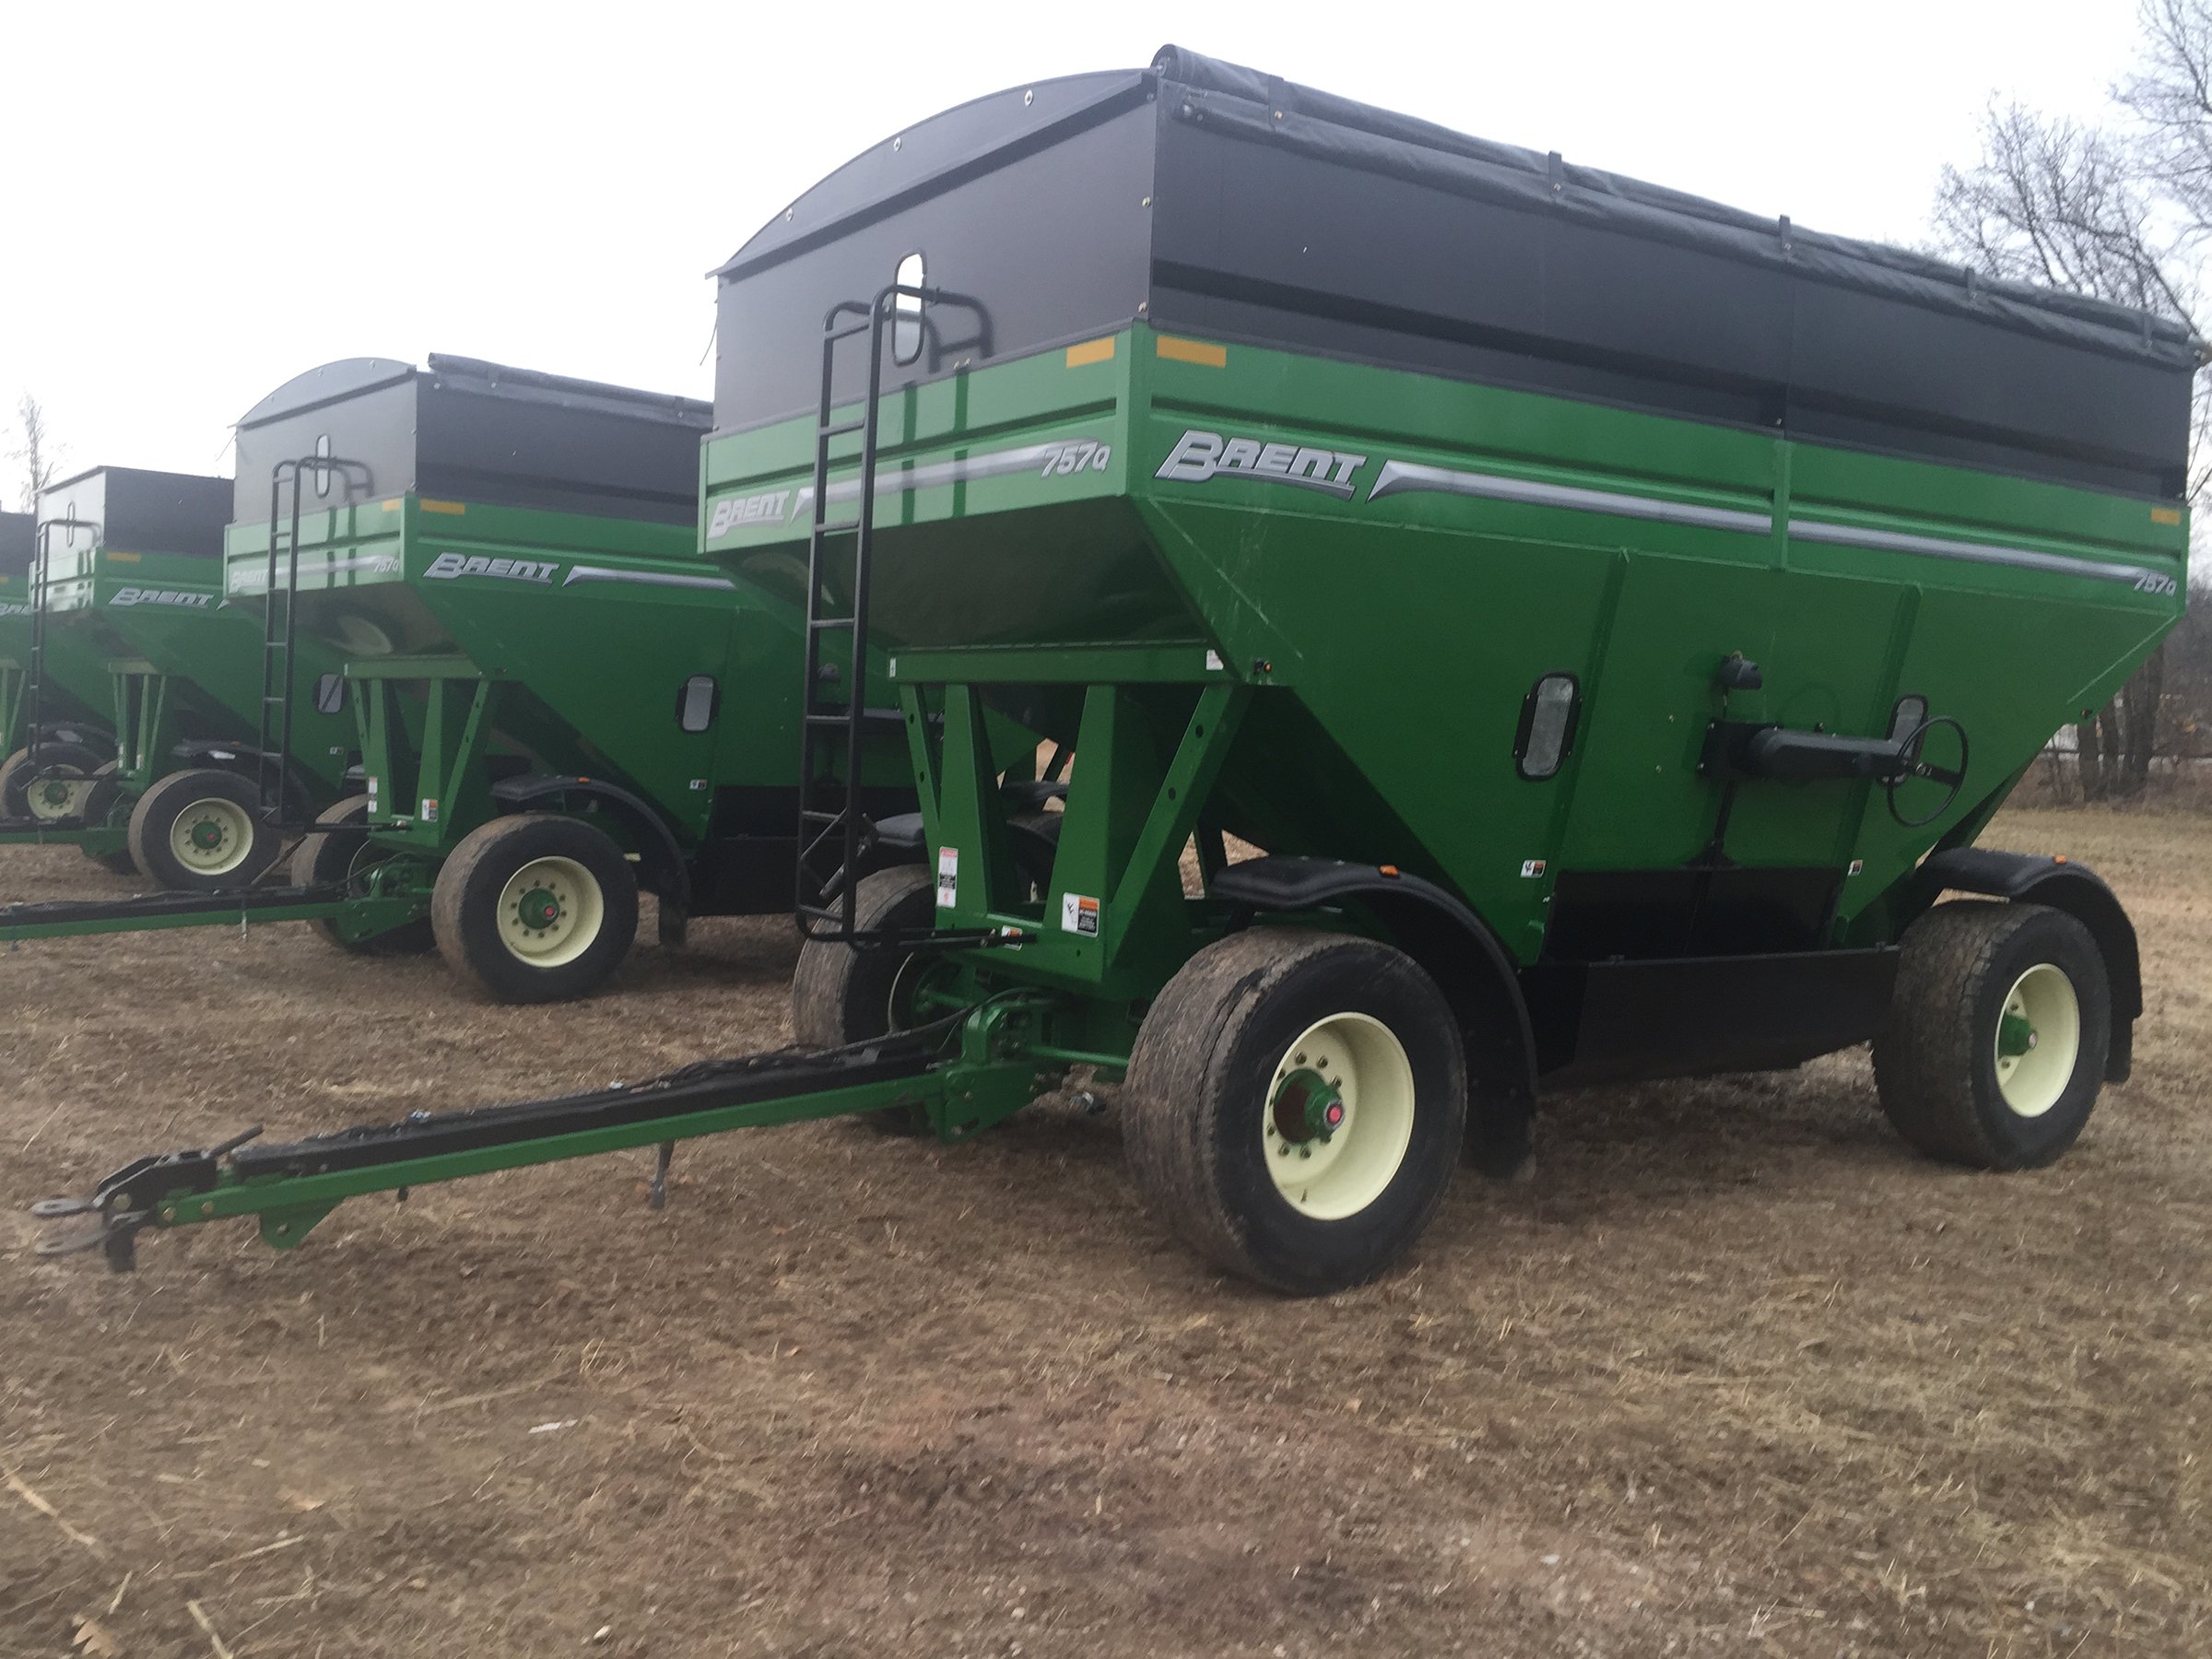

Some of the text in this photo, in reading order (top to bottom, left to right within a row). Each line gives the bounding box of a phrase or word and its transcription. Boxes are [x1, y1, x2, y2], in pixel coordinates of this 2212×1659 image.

[1041, 442, 1112, 478] 757Q
[1154, 429, 1368, 490] BRENT
[707, 490, 791, 540] BRENT
[422, 552, 559, 582] BRENT
[109, 587, 214, 608] BRENT
